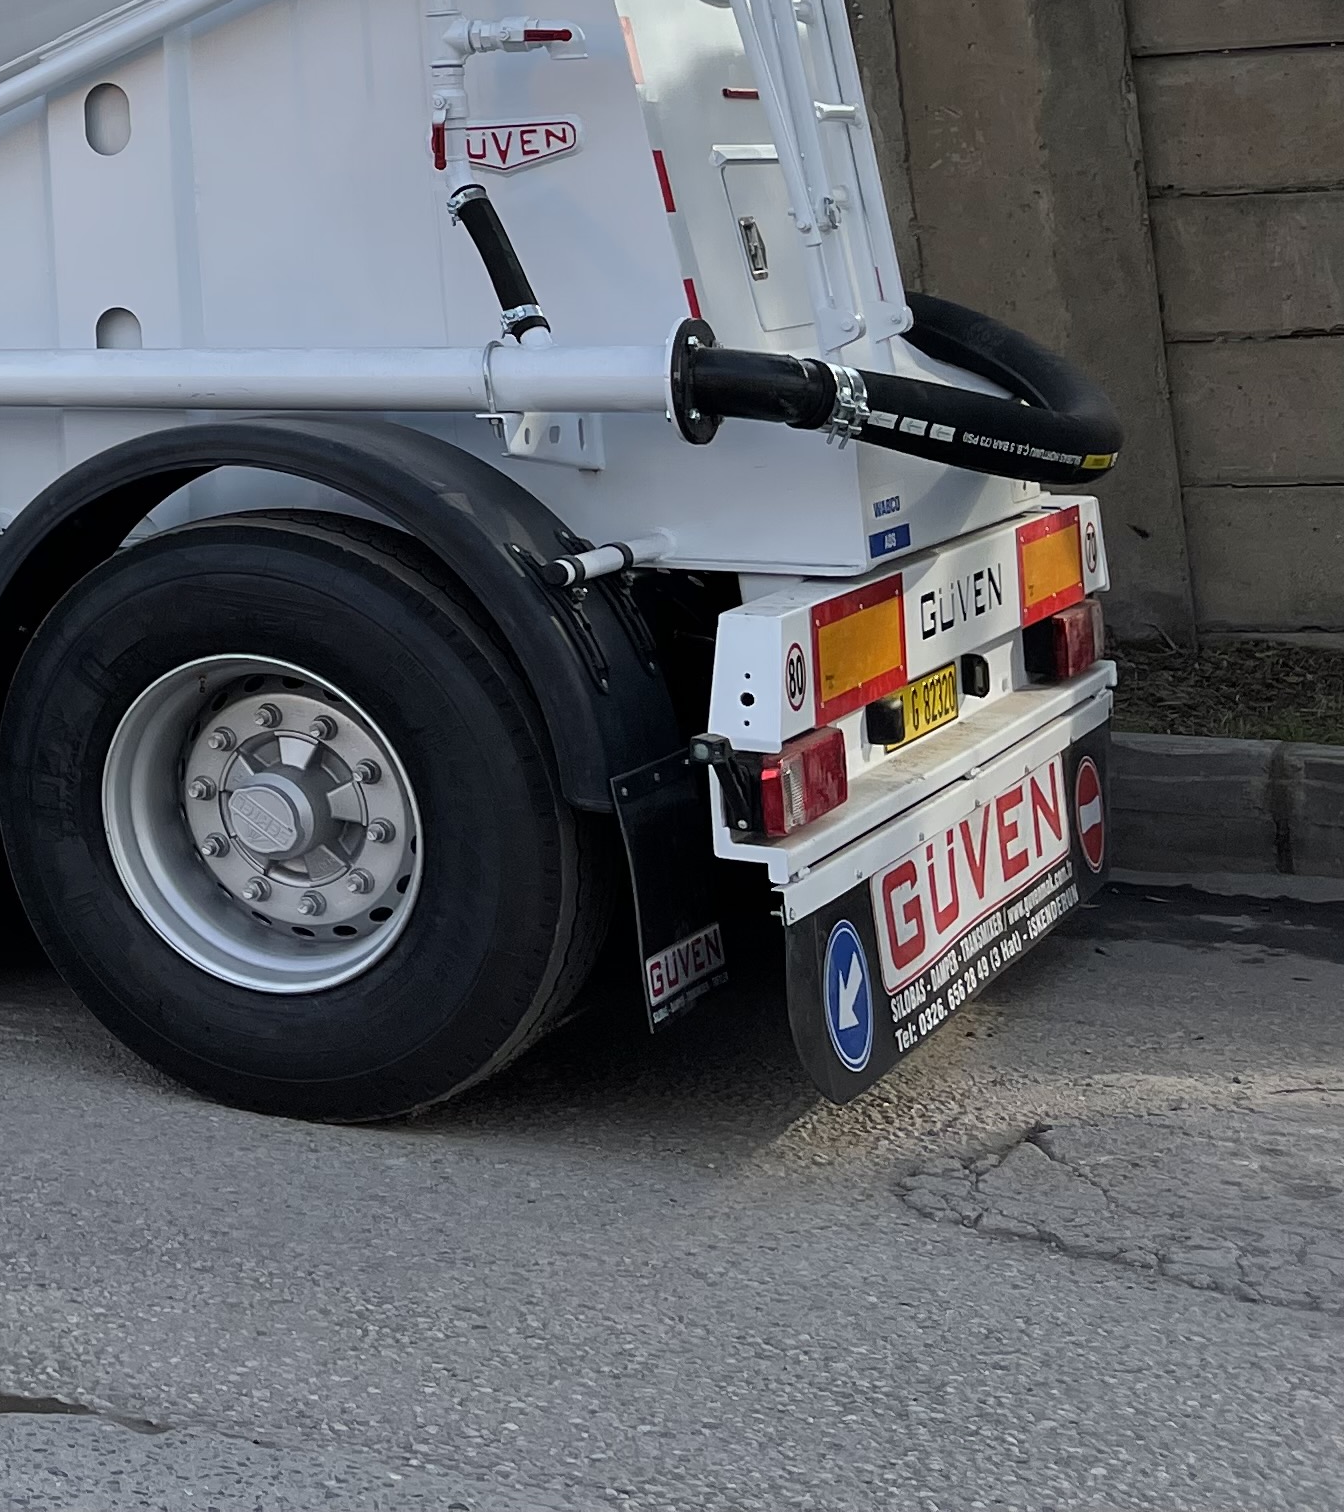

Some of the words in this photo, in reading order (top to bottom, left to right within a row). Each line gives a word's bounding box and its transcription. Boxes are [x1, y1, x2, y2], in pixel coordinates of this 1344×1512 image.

[466, 128, 567, 164] ÜVEN
[992, 439, 1010, 452] BAR
[873, 496, 900, 518] WABCO
[920, 563, 1003, 640] GÜVEN
[788, 655, 803, 699] 80
[912, 688, 919, 731] G
[923, 670, 956, 726] 82320
[882, 761, 1062, 970] GÜVEN
[650, 928, 722, 998] GÜVEN
[930, 949, 959, 992] DAMPER
[895, 1022, 918, 1052] Tel:
[947, 979, 966, 1010] 656
[964, 967, 977, 994] 28
[976, 956, 990, 980] 49
